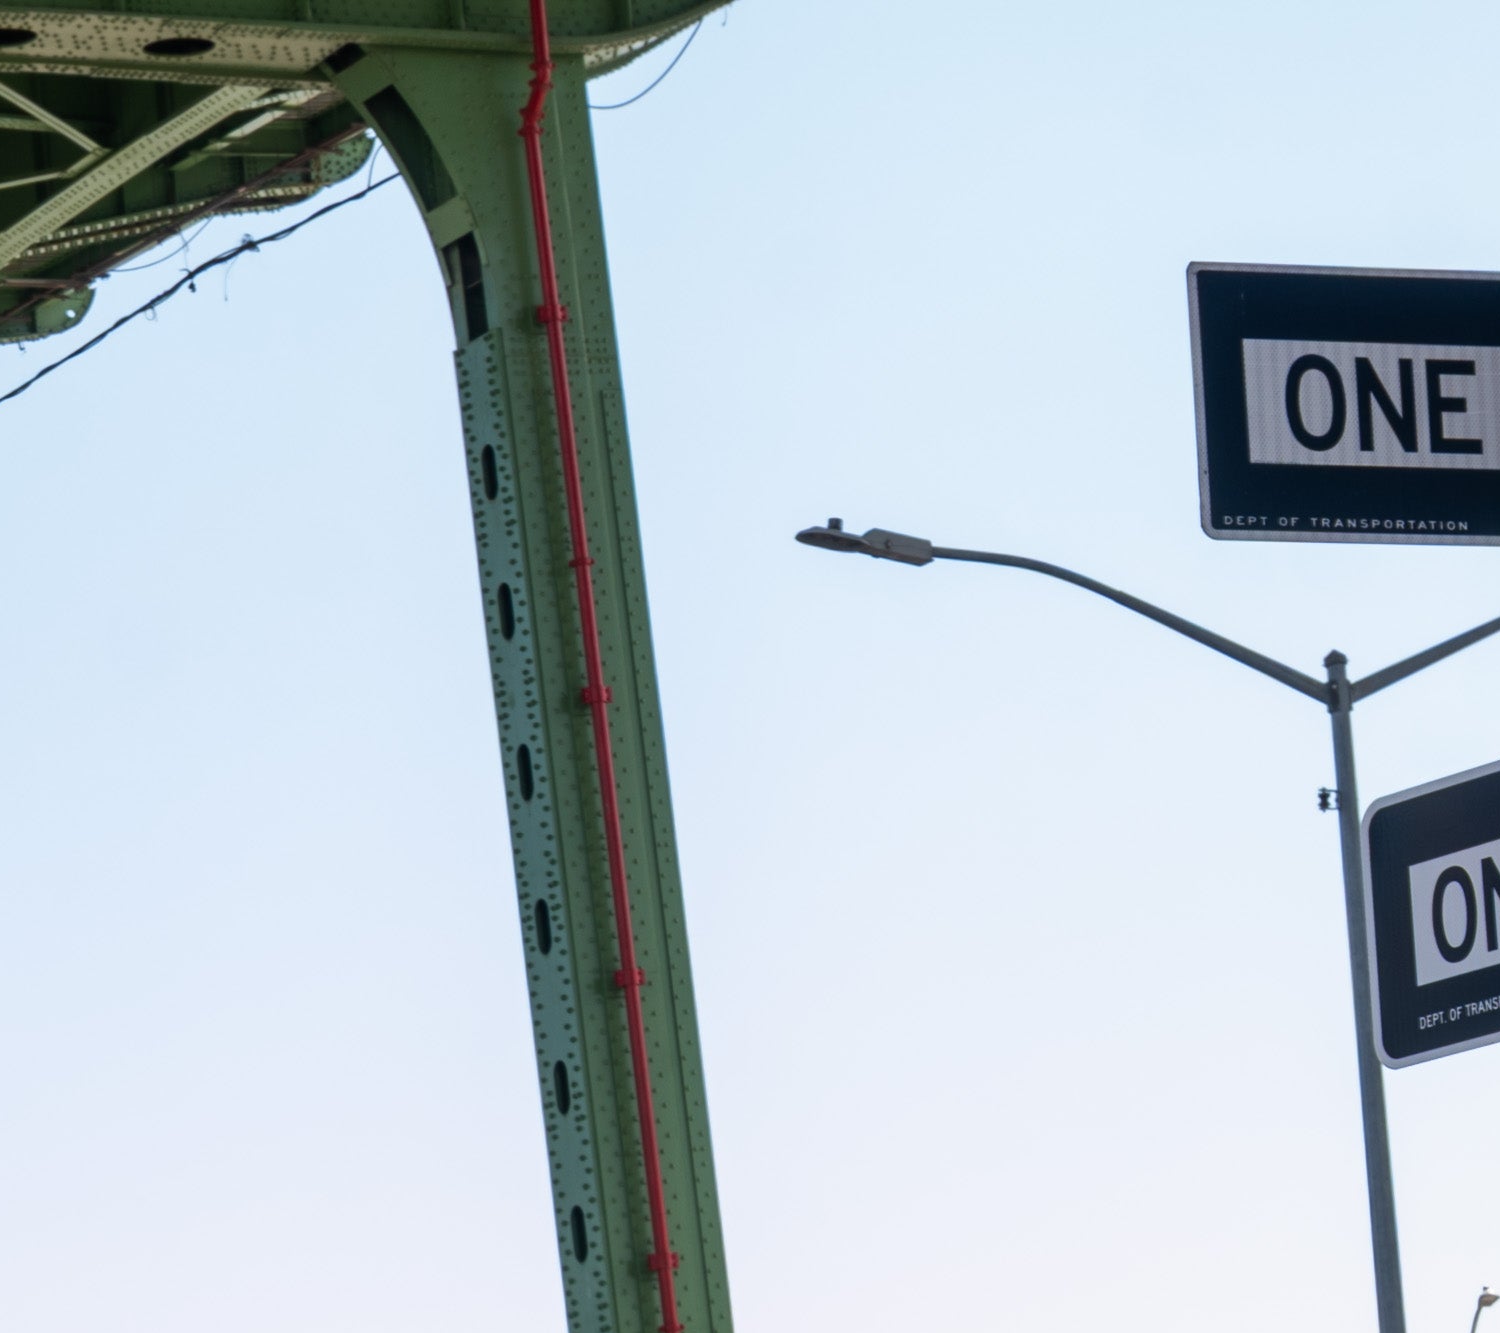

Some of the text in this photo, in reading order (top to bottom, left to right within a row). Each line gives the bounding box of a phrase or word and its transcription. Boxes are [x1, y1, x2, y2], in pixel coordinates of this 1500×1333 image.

[1284, 353, 1484, 456] ONE
[1223, 514, 1470, 532] DEPT OF TRANSPORTATION
[1418, 1008, 1448, 1031] DEPT.
[1450, 1005, 1463, 1020] OF
